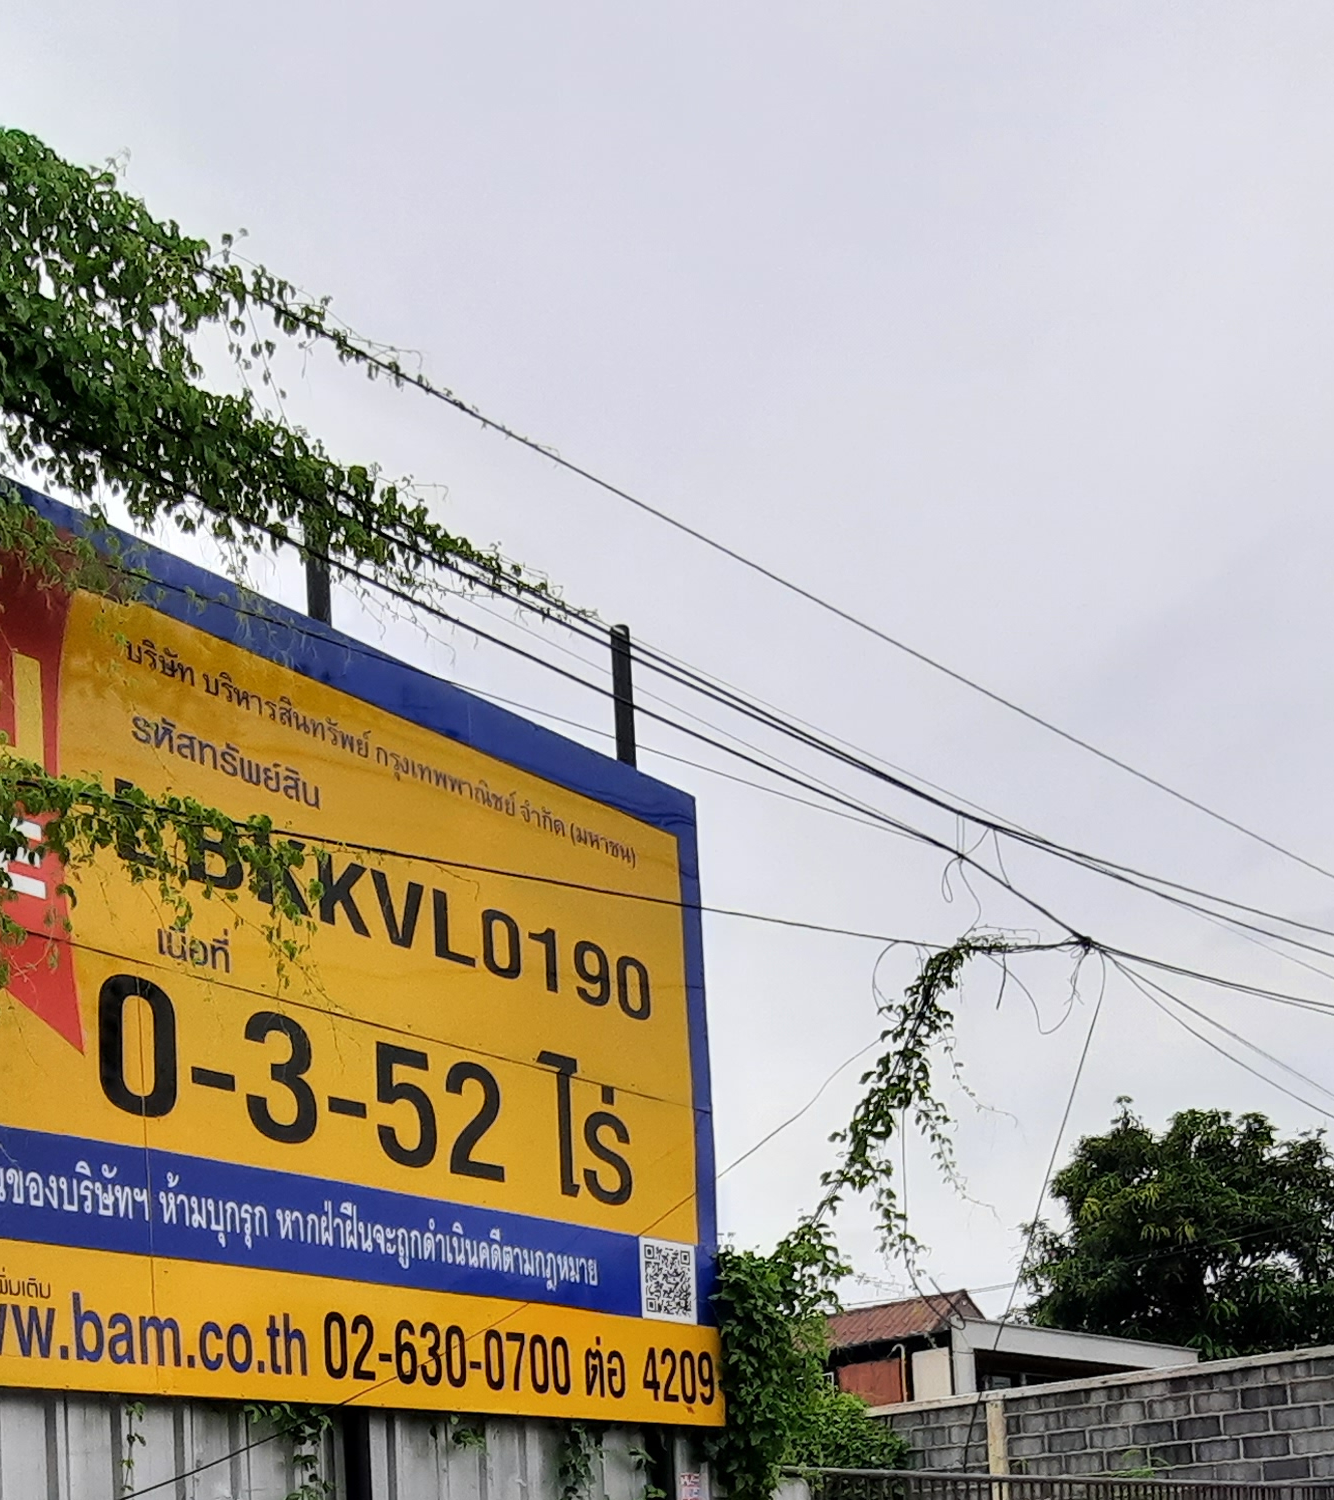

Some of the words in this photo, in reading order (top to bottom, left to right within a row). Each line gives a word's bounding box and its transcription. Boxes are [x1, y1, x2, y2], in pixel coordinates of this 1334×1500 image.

[125, 638, 195, 686] บริษัท
[202, 671, 372, 758] บริหารสินทรัพย์
[375, 744, 518, 817] กรุงเทพพาณิชย์
[519, 799, 566, 839] จำกัด
[569, 821, 637, 869] (มหาชน)
[130, 715, 322, 811] รหัสทรัพย์สิน
[156, 925, 231, 974] เนือที่
[97, 973, 506, 1182] 0-3-52
[537, 1049, 634, 1206] ไร่
[158, 1173, 269, 1250] ห้ามบุกรุก
[323, 1310, 571, 1396] 02-630-0700
[584, 1335, 627, 1399] ต่อ
[641, 1345, 716, 1406] 4209
